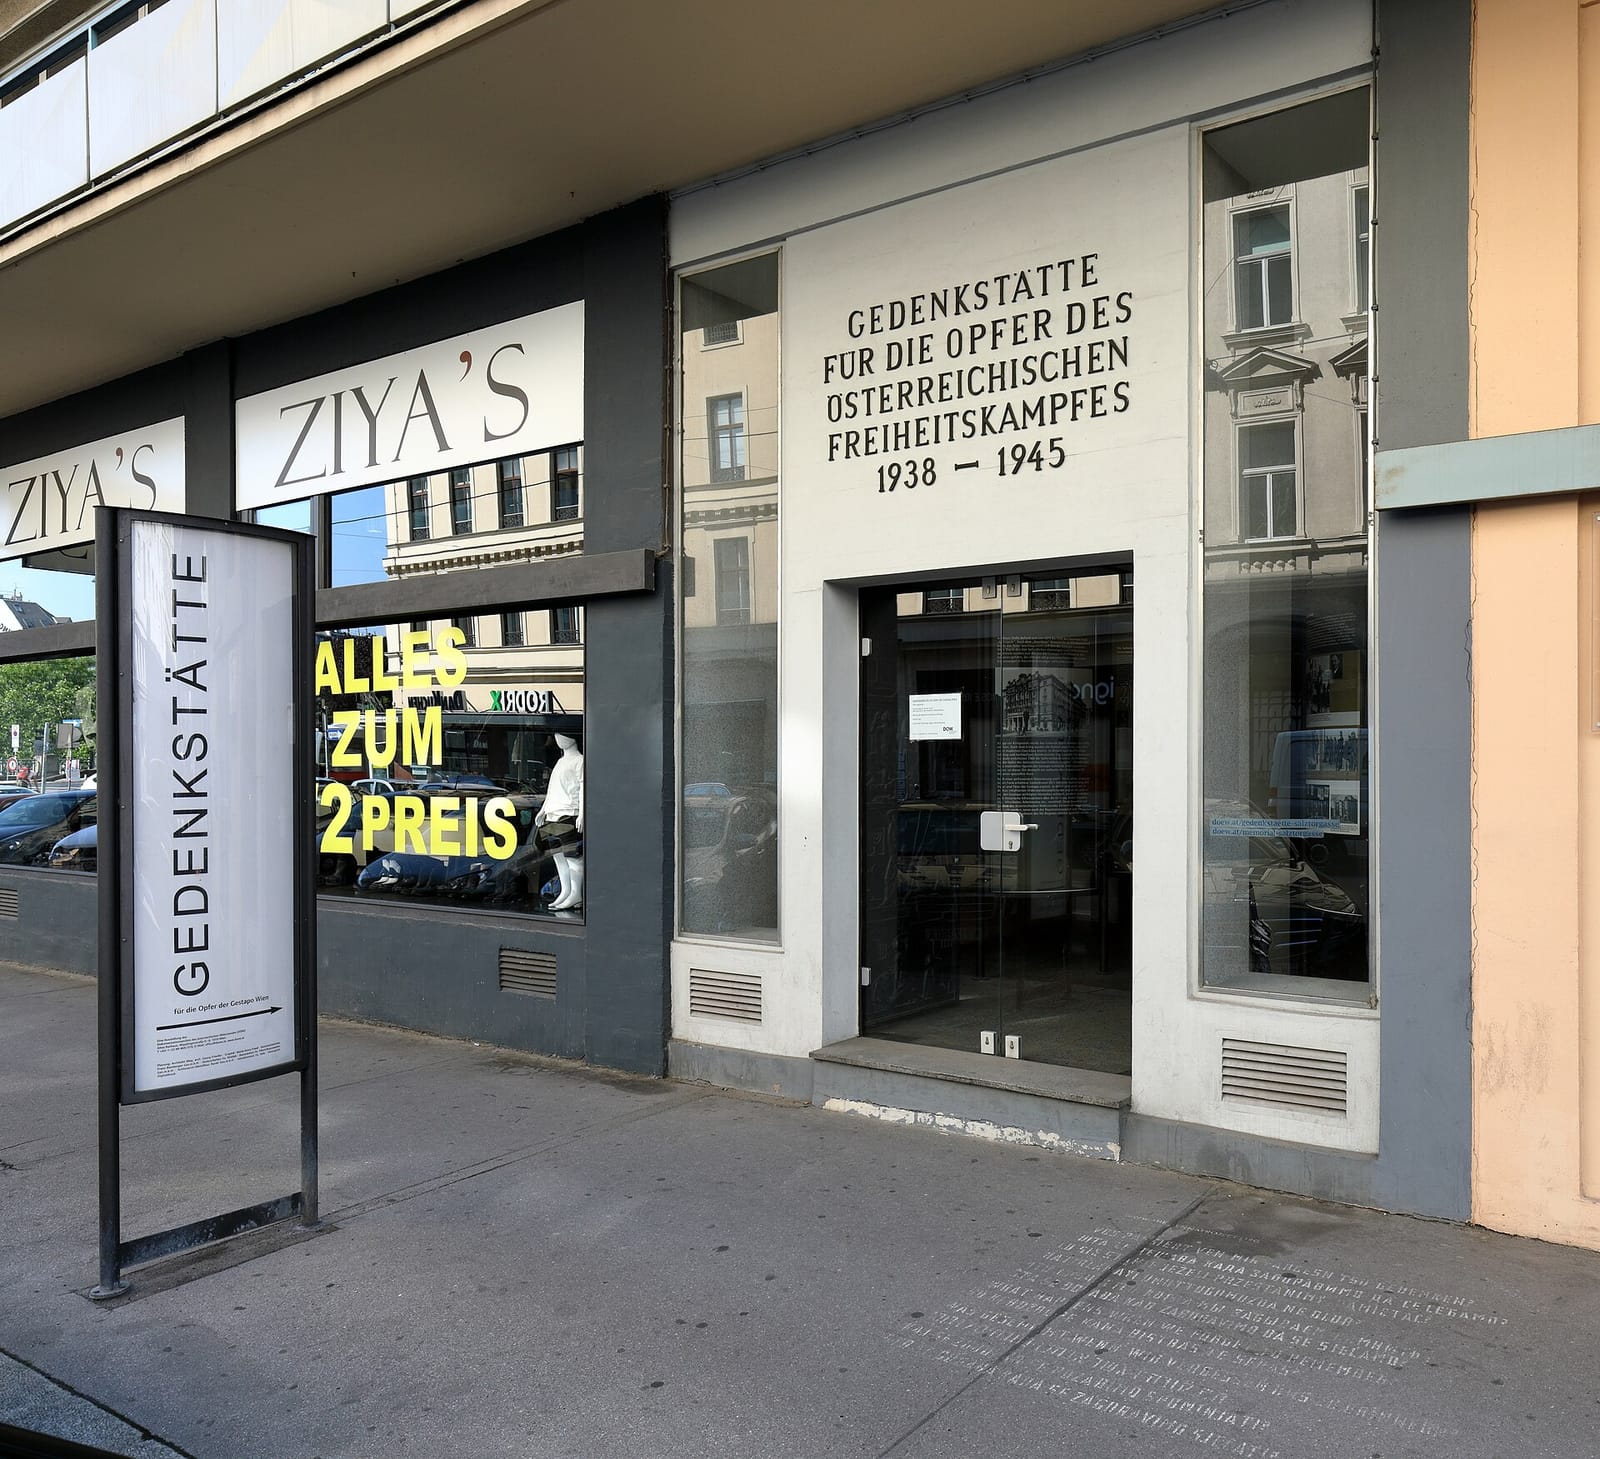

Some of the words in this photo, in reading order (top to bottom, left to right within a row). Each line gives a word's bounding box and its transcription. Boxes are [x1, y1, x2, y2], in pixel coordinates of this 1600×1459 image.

[848, 253, 1098, 338] GEDENKSTÄTTE
[823, 347, 874, 384] FÜR
[886, 334, 934, 371] DIE
[946, 308, 1051, 358] OPFER
[1066, 291, 1133, 335] DES
[827, 336, 1129, 422] ÖSTERREICHISCHEN
[828, 381, 1130, 462] FREIHEITSKAMPFES
[877, 457, 936, 493] 1938
[997, 437, 1066, 476] 1945
[316, 627, 467, 695] ALLES
[165, 553, 210, 996] GEDENKSTÄTTE
[331, 705, 443, 769] ZUM
[316, 782, 353, 854] 2
[362, 795, 518, 860] PREIS
[198, 1003, 217, 1012] Opfer
[218, 1001, 229, 1009] der
[230, 998, 254, 1007] Gestapo
[255, 994, 269, 1003] Wien
